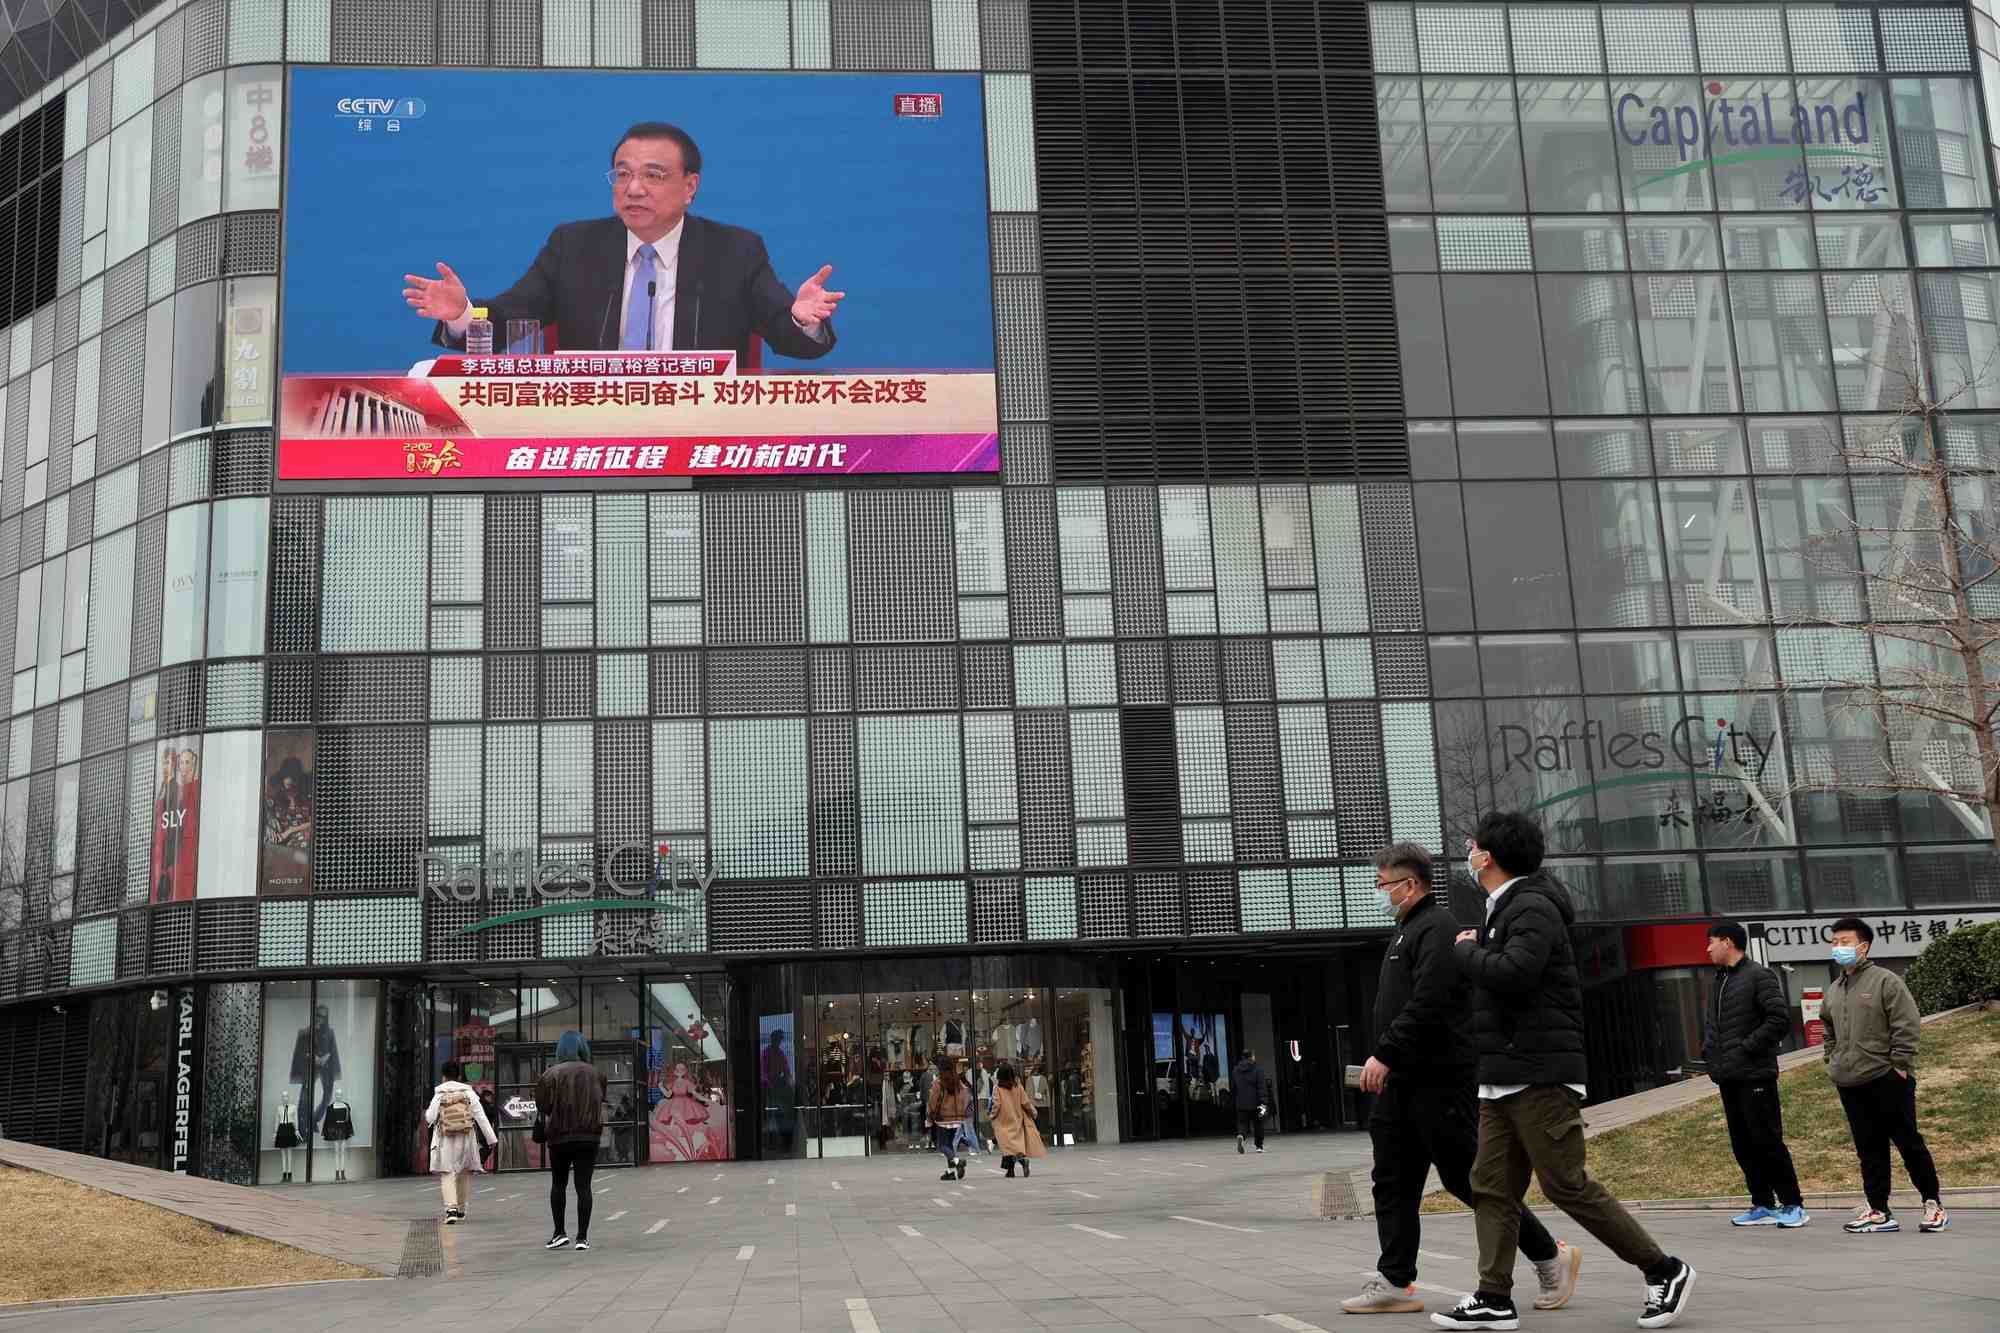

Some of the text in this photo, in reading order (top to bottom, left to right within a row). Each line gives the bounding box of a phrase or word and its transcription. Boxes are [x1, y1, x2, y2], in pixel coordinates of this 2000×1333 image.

[337, 98, 394, 114] CCTV
[1617, 80, 1869, 161] CapitaLand
[461, 358, 715, 376] 李克强总理就共同富裕答记者问
[459, 378, 928, 408] 共同富裕要共同奋斗 对外开放不会改变
[505, 443, 847, 471] 奋进新征程 建功新时代
[1498, 716, 1777, 777] Raffles City
[161, 808, 187, 829] SLY
[417, 841, 723, 906] Raffles City
[1766, 926, 1834, 946] CITIC
[173, 1049, 193, 1175] LAGERFEL
